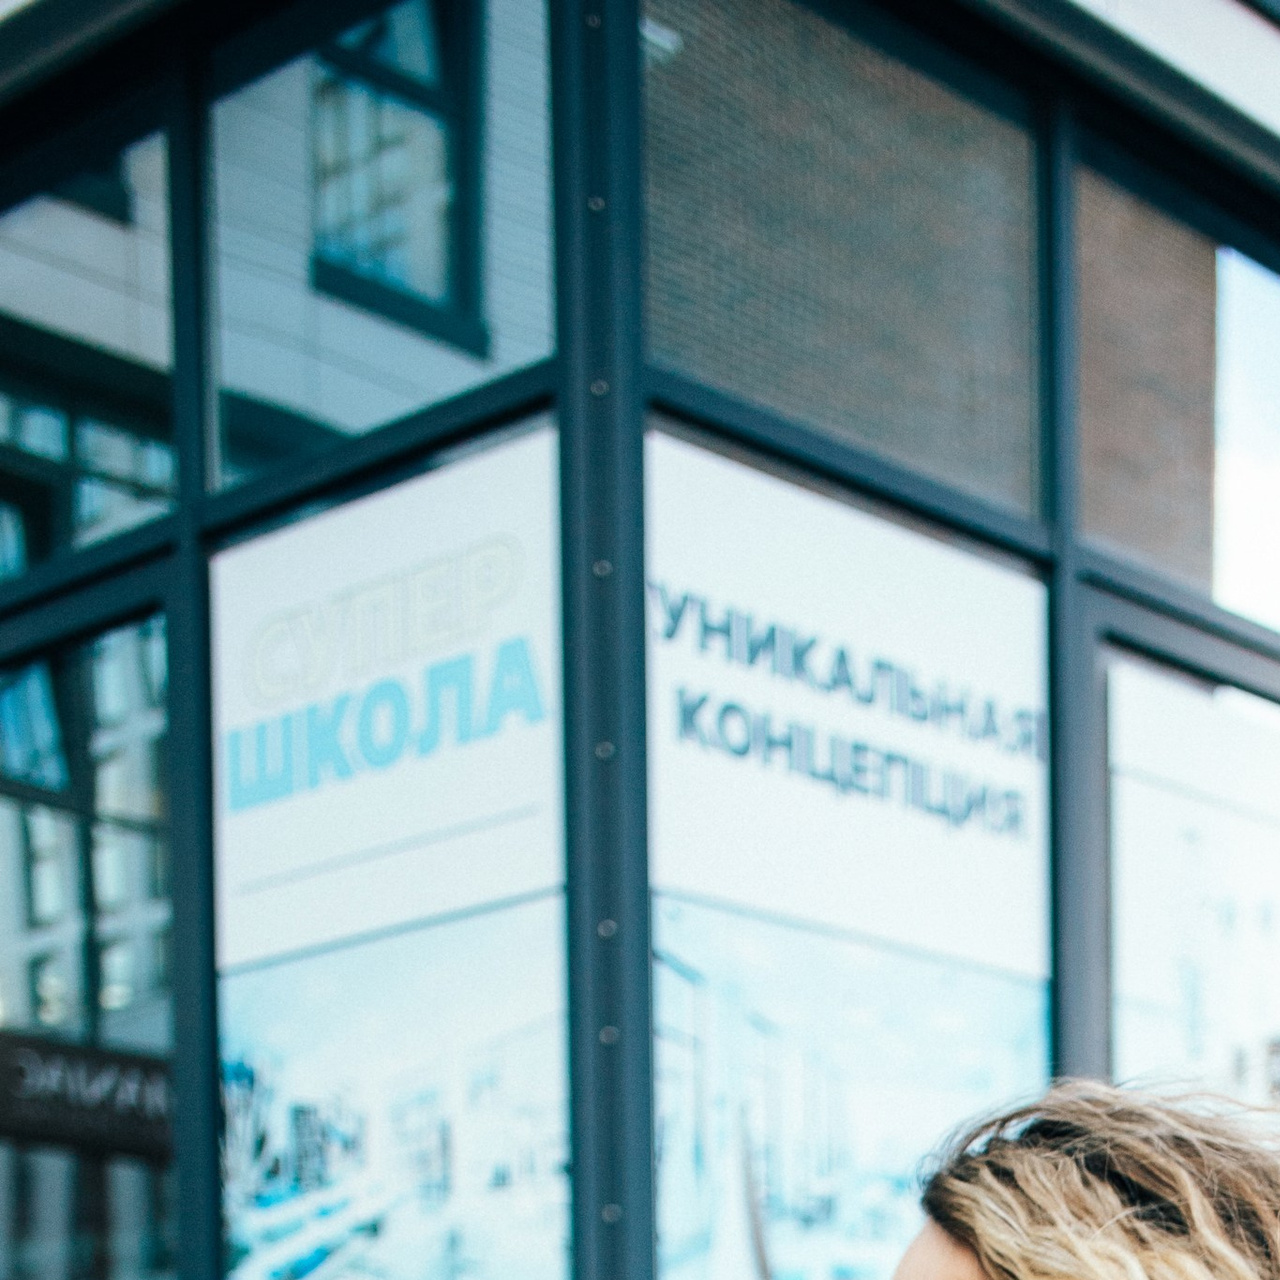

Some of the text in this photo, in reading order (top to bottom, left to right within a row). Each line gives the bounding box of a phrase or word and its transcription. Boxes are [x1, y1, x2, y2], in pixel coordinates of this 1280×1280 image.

[226, 637, 545, 811] ШКОЛА
[649, 580, 1048, 760] УНИКАЛЬНАЯ
[676, 687, 1026, 838] КОНЦЕПЦИЯ
